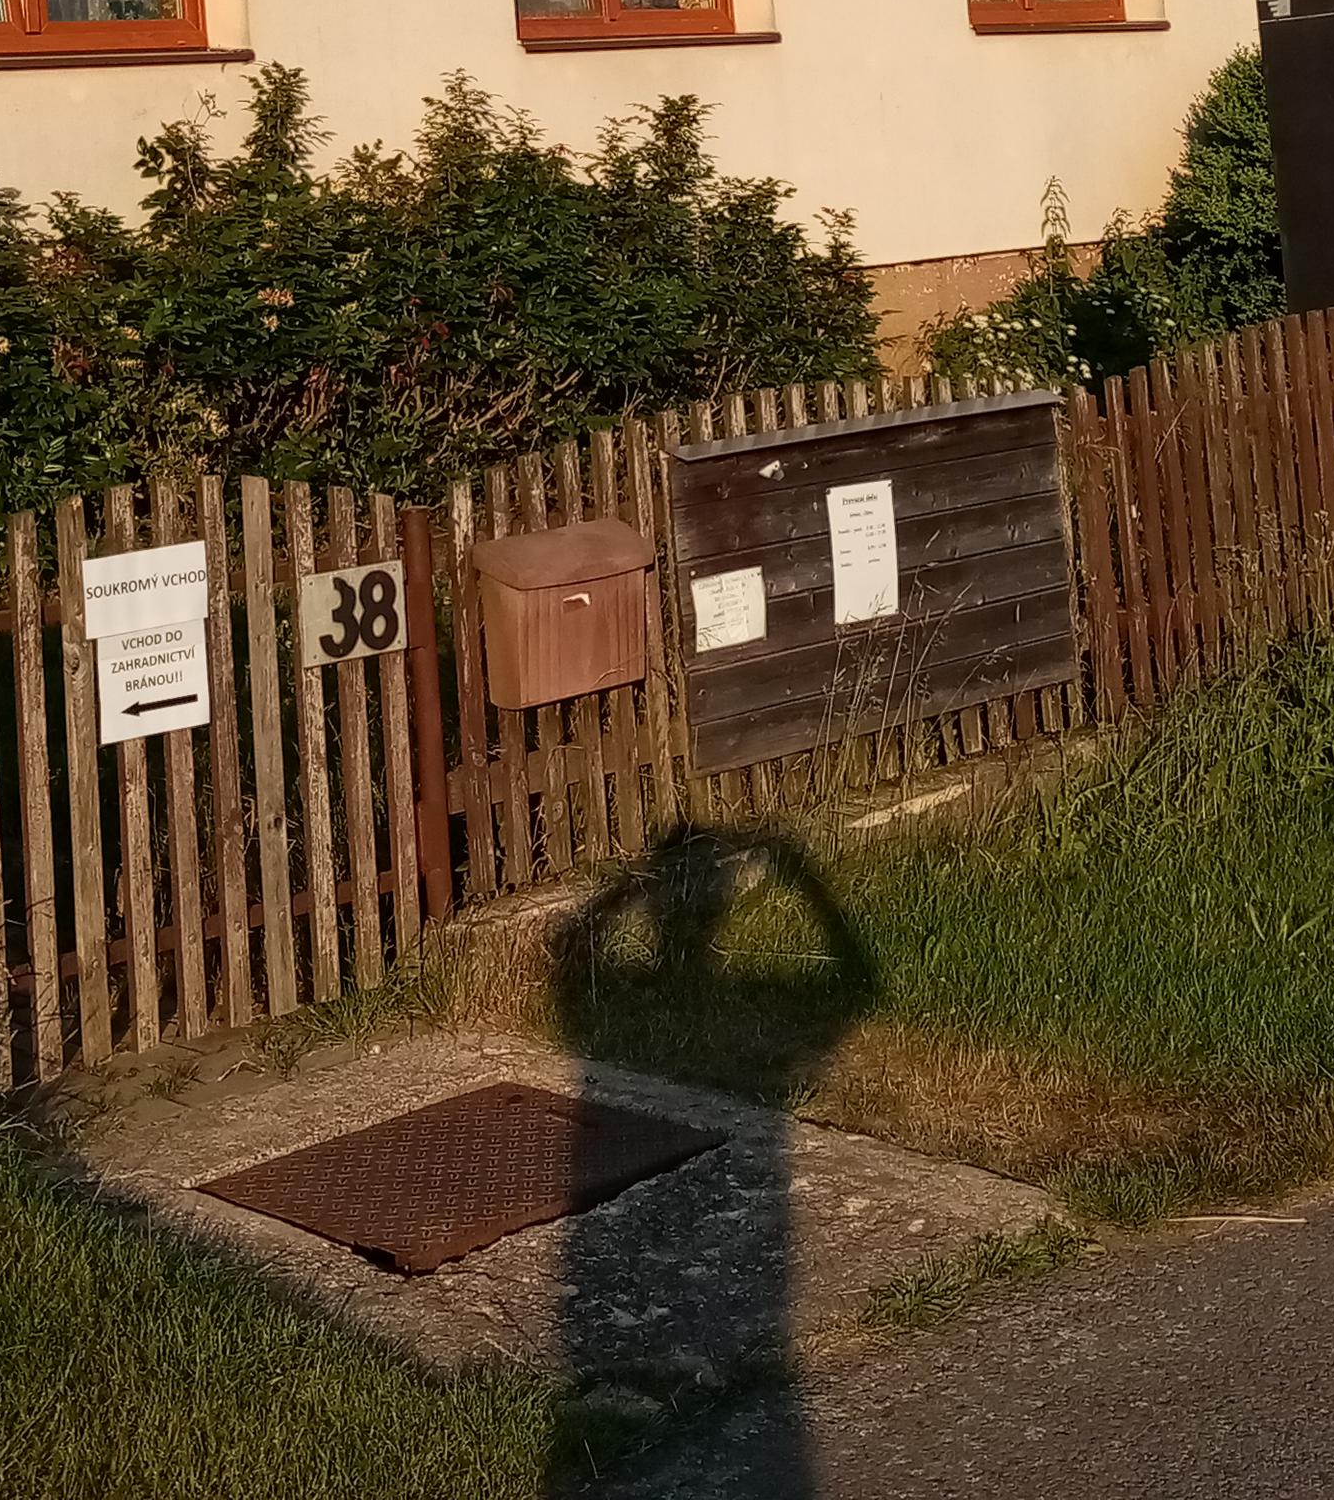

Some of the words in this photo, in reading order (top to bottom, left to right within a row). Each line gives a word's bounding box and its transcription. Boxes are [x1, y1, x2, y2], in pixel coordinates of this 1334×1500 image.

[86, 574, 159, 600] SOUKROMÝ
[162, 569, 206, 588] VCHOD
[319, 569, 399, 658] 38
[121, 632, 162, 651] VCHOD
[165, 629, 183, 643] DO
[111, 645, 195, 674] ZAHRADNICTVÍ
[125, 670, 183, 692] BRÁNOU!!
